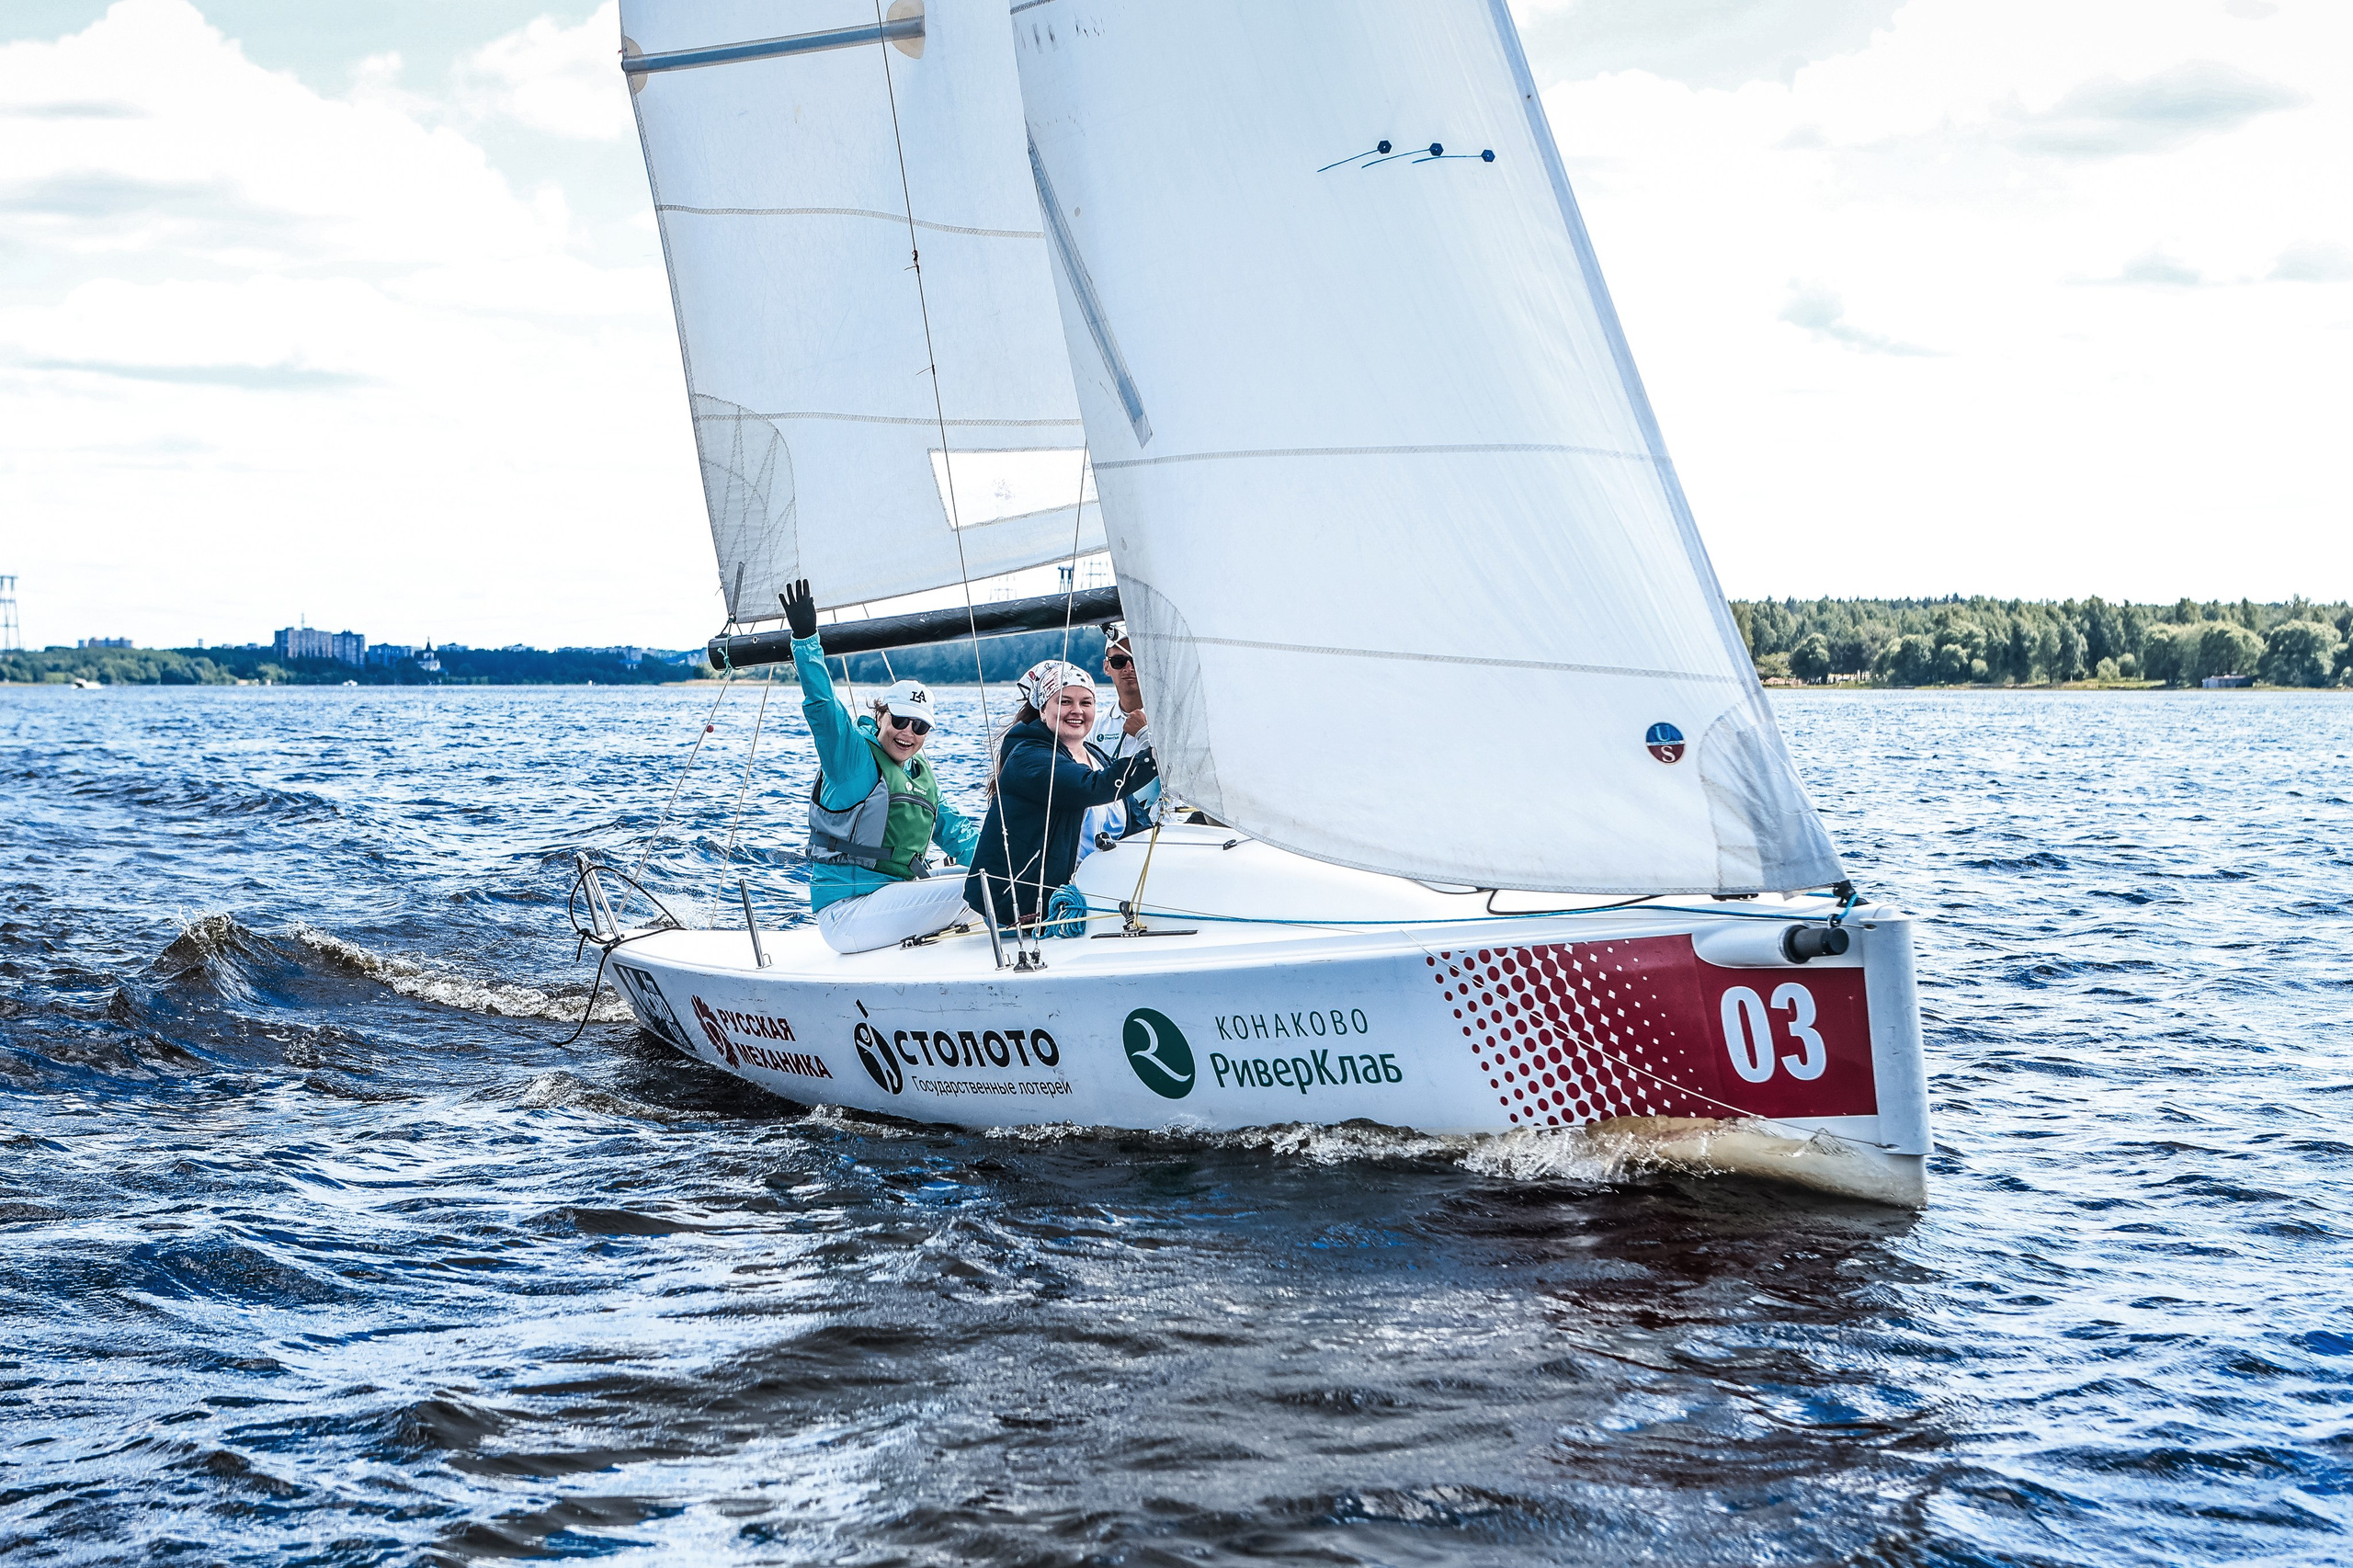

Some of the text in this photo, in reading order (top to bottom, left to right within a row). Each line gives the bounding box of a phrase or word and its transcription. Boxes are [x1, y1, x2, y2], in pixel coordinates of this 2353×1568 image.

[910, 690, 926, 703] LA
[1654, 724, 1671, 742] U
[1660, 745, 1676, 762] S
[716, 1008, 797, 1041] РУССКАЯ
[1214, 1008, 1369, 1040] КОНАКОВО
[1721, 982, 1827, 1083] 03
[734, 1041, 834, 1079] МЕХАНИКА
[893, 1028, 1060, 1068] СТОЛОТО
[912, 1075, 1073, 1098] Государственные лотереи
[1209, 1049, 1404, 1095] РиверКлаб
